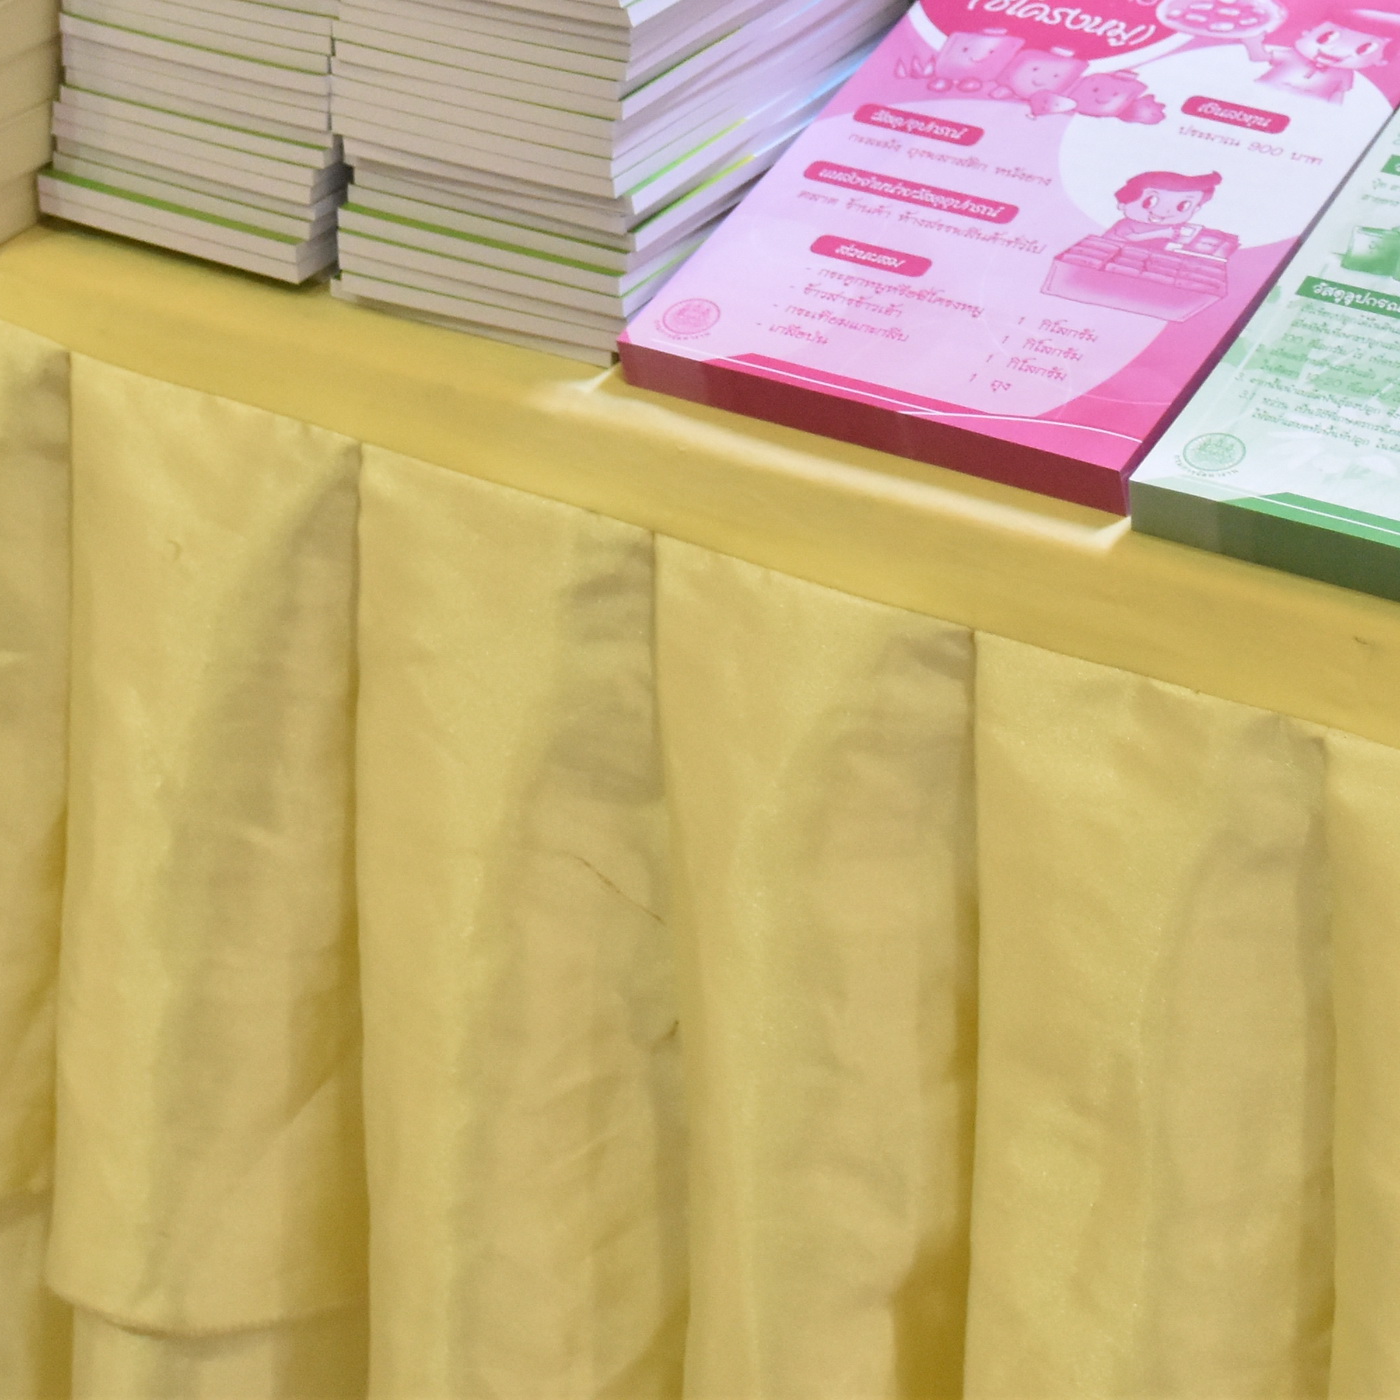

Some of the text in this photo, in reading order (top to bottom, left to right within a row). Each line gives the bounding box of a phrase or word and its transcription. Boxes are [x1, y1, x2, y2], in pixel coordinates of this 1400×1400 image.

[1193, 100, 1276, 129] เงินลงทุน
[1245, 140, 1286, 157] 900
[1287, 151, 1325, 166] บาท
[841, 195, 897, 219] ร้านค้า
[1035, 315, 1105, 344] กิโลกรัม
[1020, 334, 1088, 362] กิโลกรัม
[1003, 353, 1073, 382] กิโลกรัม
